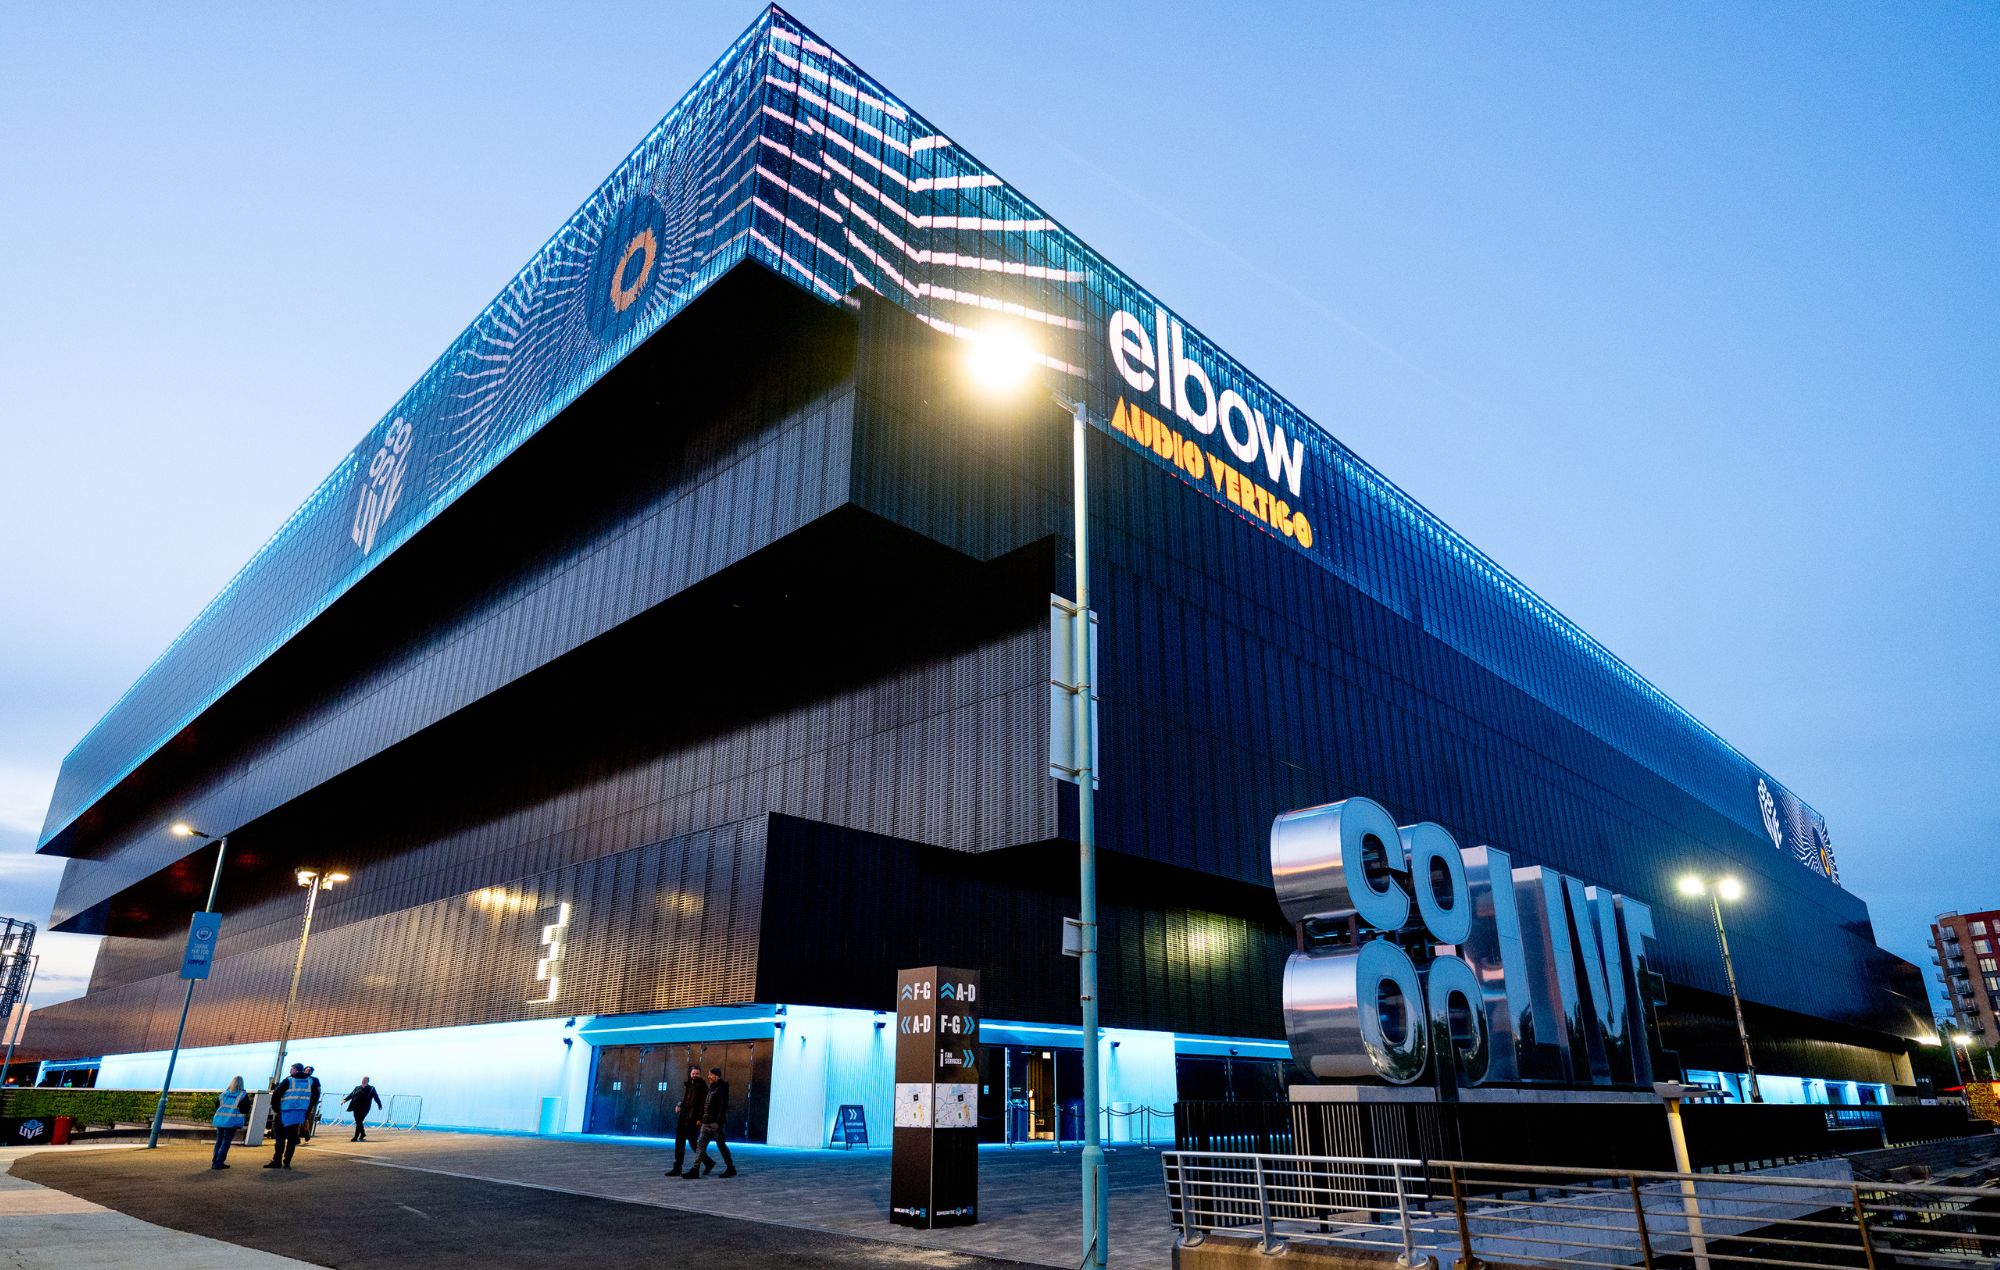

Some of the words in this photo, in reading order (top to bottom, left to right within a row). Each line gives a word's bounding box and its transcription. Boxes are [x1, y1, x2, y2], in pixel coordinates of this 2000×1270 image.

[1109, 303, 1304, 497] elbow
[1111, 395, 1205, 480] AUDIO
[1206, 452, 1313, 548] VERTIGO
[1458, 845, 1682, 1088] LIVE
[913, 981, 931, 1001] F-G
[956, 983, 976, 1002] A-D
[912, 1014, 931, 1034] A-D
[940, 1015, 961, 1034] F-G
